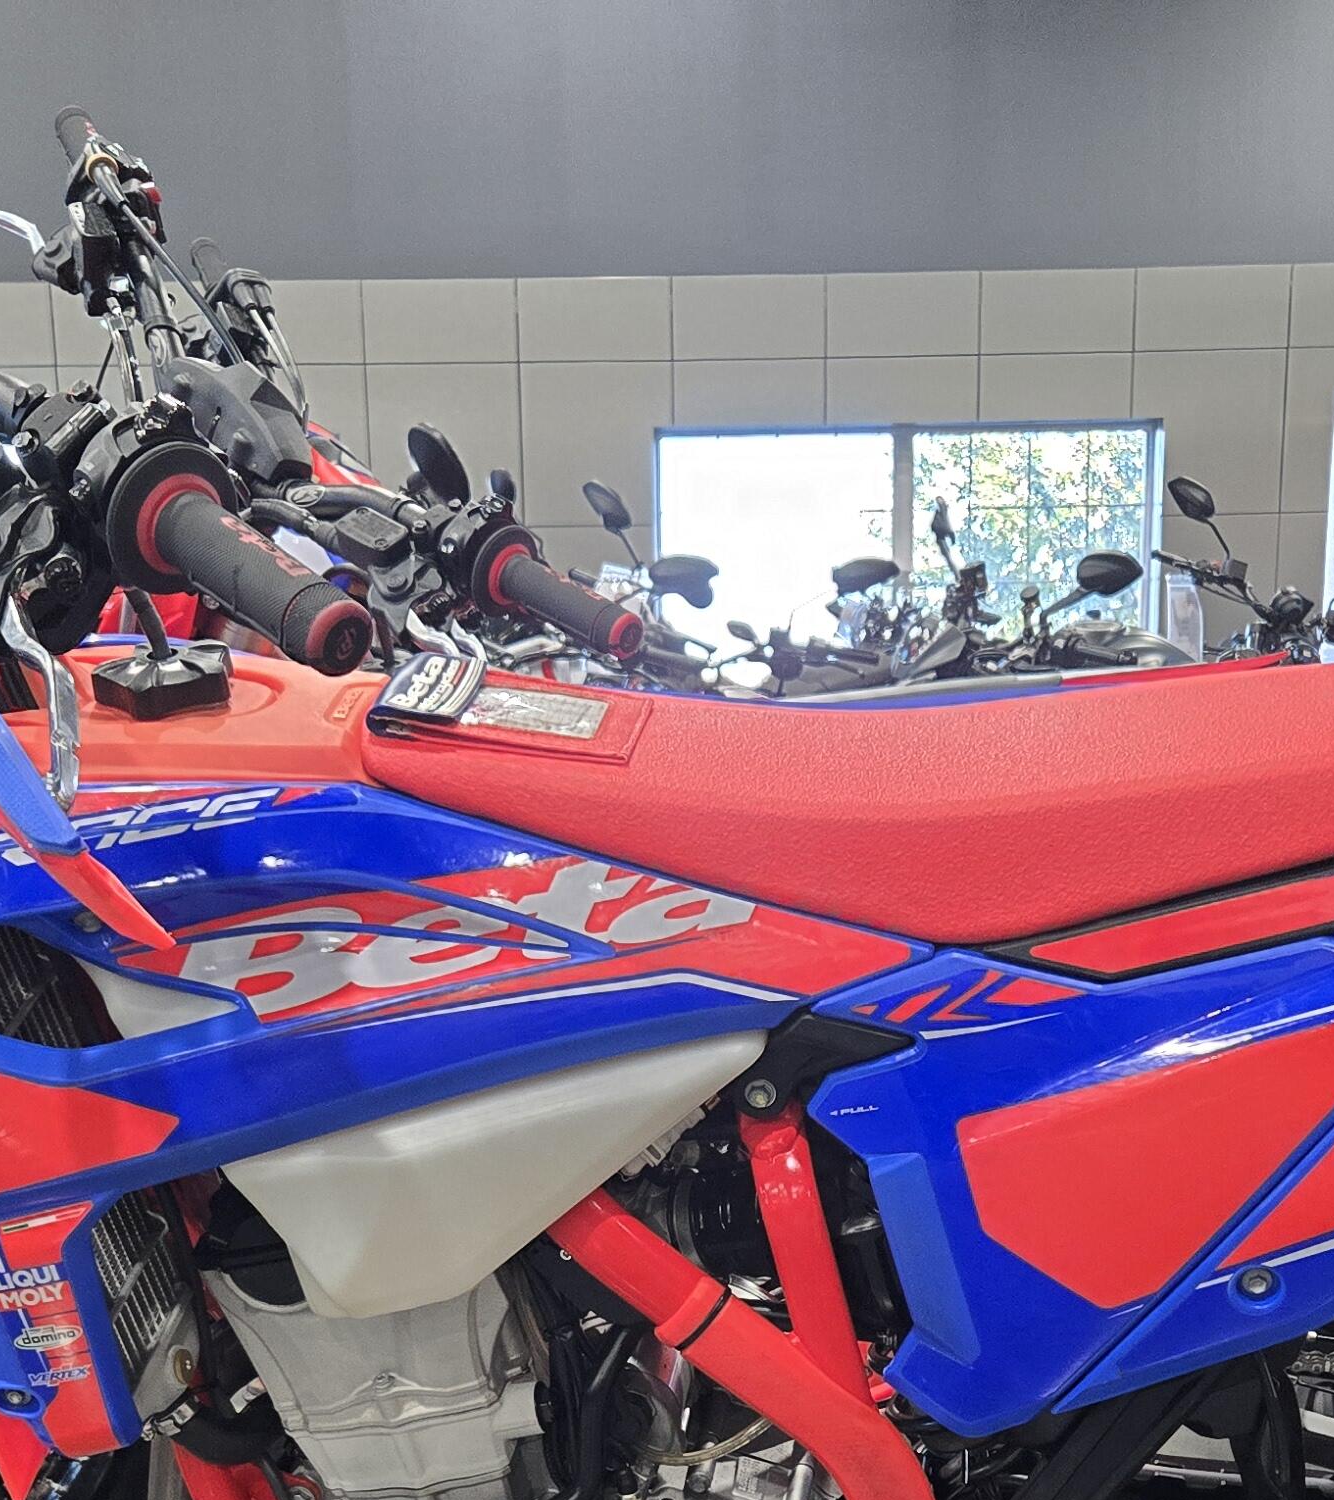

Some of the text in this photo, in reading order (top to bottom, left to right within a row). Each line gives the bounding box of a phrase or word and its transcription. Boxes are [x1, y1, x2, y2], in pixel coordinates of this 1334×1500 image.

[388, 655, 447, 708] Beta
[178, 860, 758, 1017] Beta
[840, 1105, 879, 1117] PULL
[22, 1329, 77, 1346] domino
[29, 1366, 89, 1383] VERTEX
